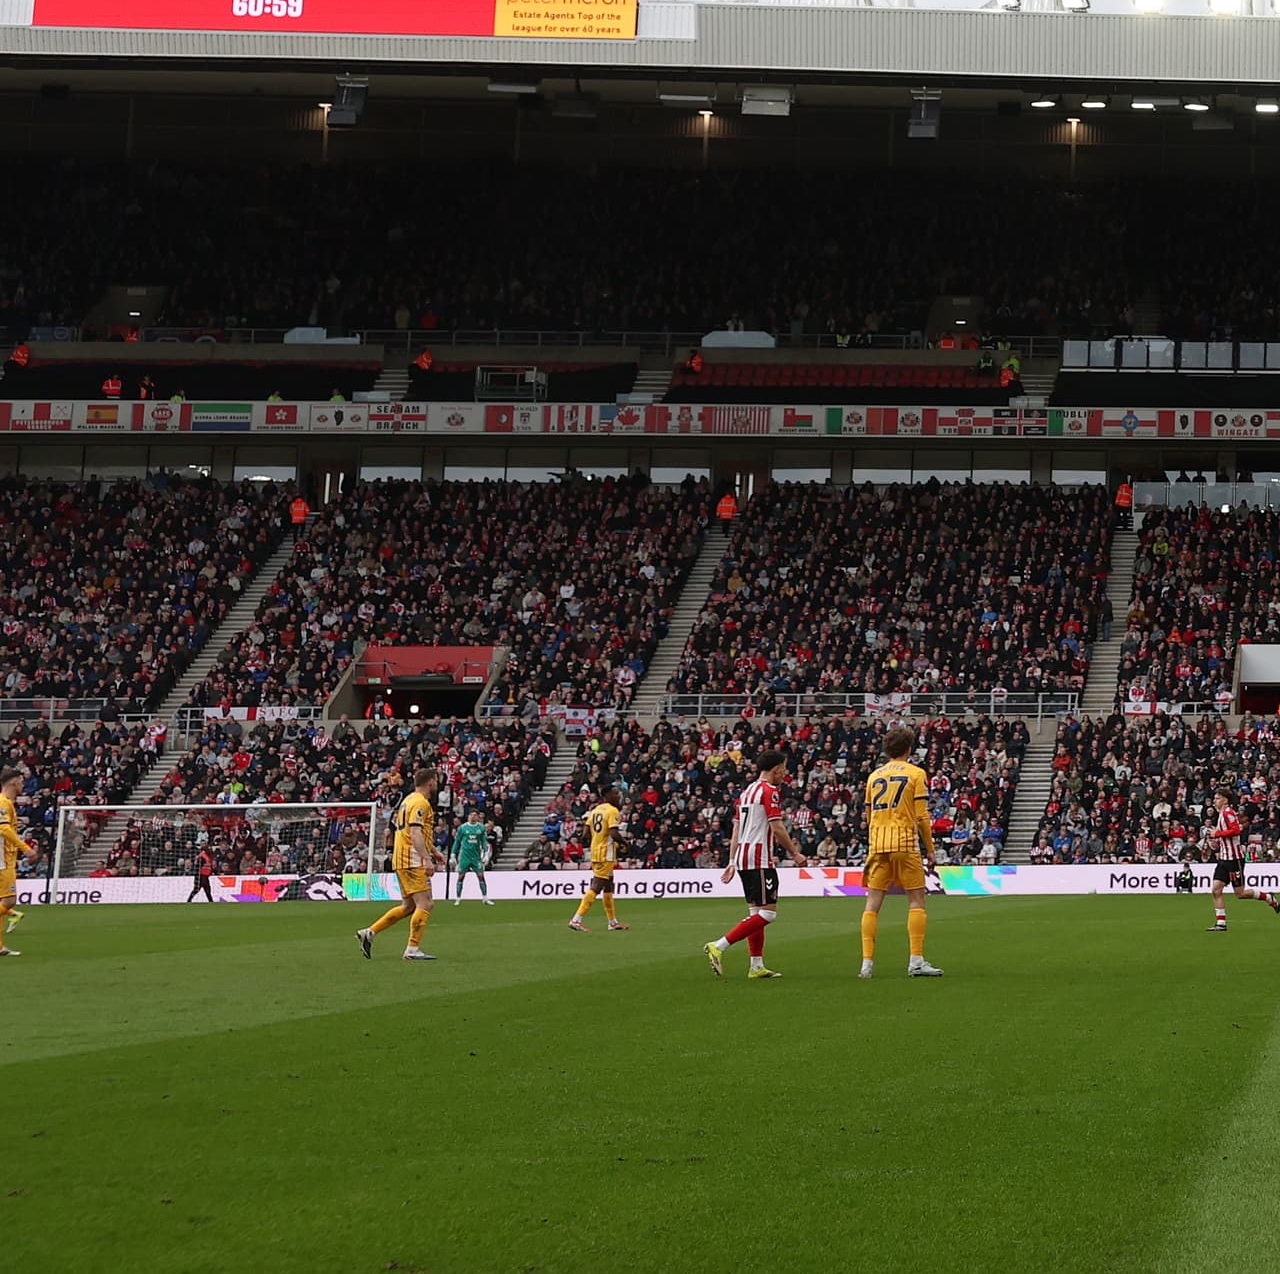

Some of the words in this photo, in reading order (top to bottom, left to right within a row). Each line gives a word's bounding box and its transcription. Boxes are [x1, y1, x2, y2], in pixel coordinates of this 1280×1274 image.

[513, 10, 541, 20] Estate
[544, 11, 575, 21] Agents
[578, 12, 594, 22] Top
[596, 12, 604, 21] of
[607, 13, 622, 21] the
[512, 24, 542, 33] league
[545, 24, 557, 33] for
[560, 26, 580, 34] over
[582, 25, 594, 34] 60
[596, 27, 621, 35] years
[872, 776, 909, 811] 27
[592, 813, 604, 834] 18
[522, 879, 575, 896] More
[634, 881, 652, 894] a
[653, 882, 713, 898] game
[1110, 873, 1160, 889] More
